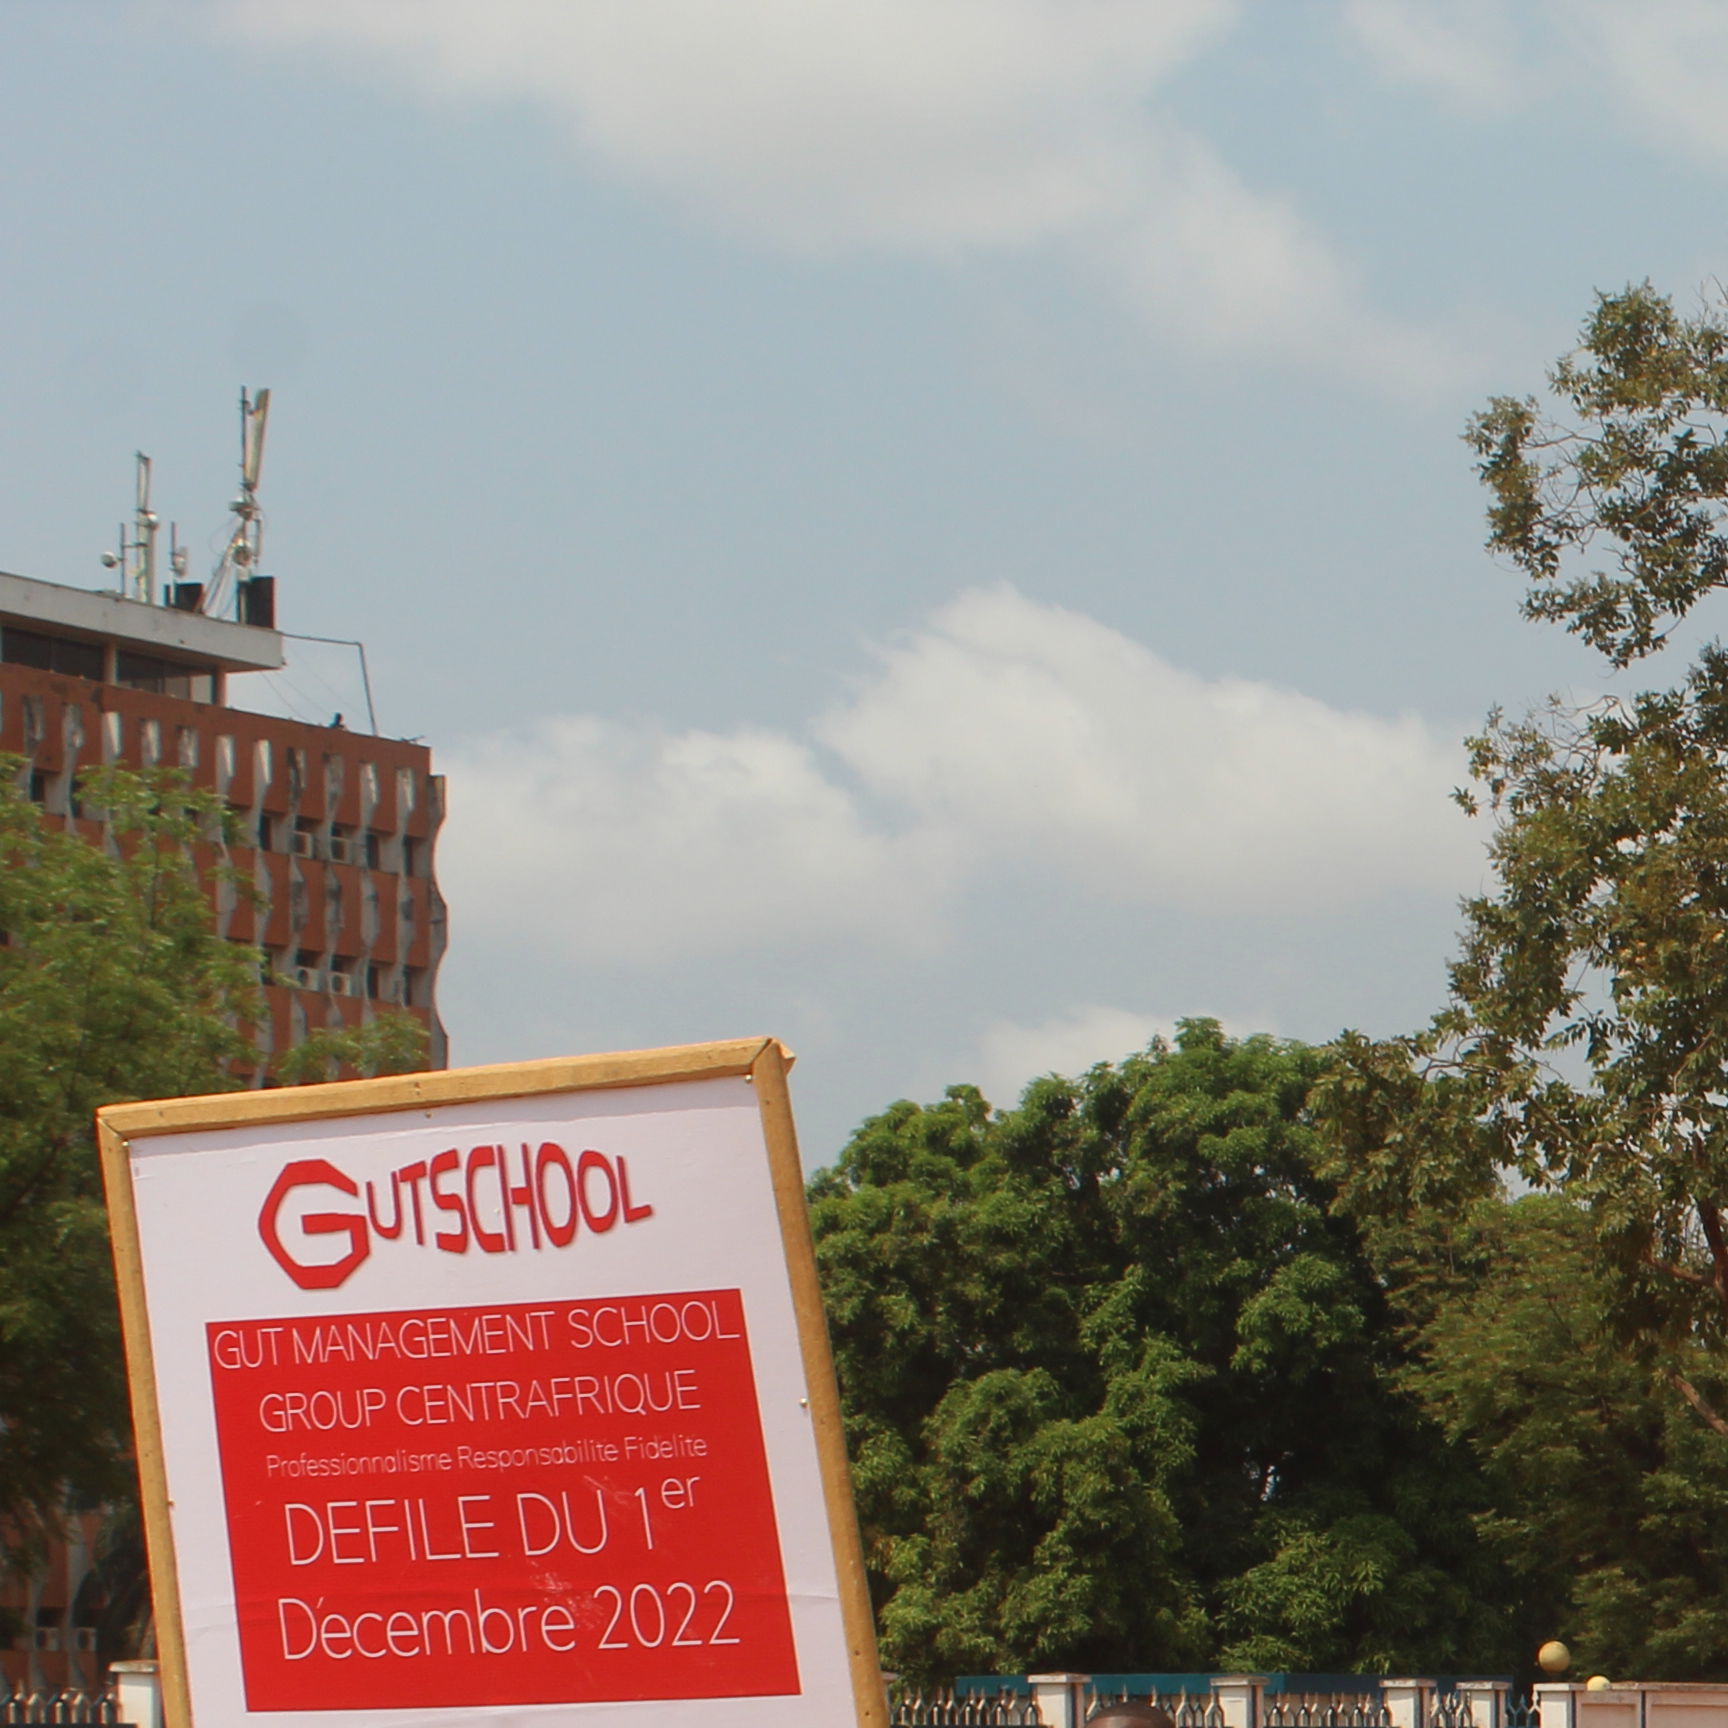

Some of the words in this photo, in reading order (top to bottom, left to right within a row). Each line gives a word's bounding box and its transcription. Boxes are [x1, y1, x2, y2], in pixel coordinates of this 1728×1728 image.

[258, 1141, 655, 1290] GUTSCHOOL
[213, 1327, 284, 1370] GUT
[292, 1310, 555, 1365] MANAGEMENT
[568, 1300, 740, 1350] SCHOOL
[258, 1387, 387, 1433] GROUP
[396, 1369, 701, 1426] CENTRAFRIQUE
[266, 1447, 452, 1478] Professionnalisme
[283, 1494, 500, 1566] DEFILE
[517, 1489, 608, 1557] DU
[594, 1579, 741, 1650] 2022
